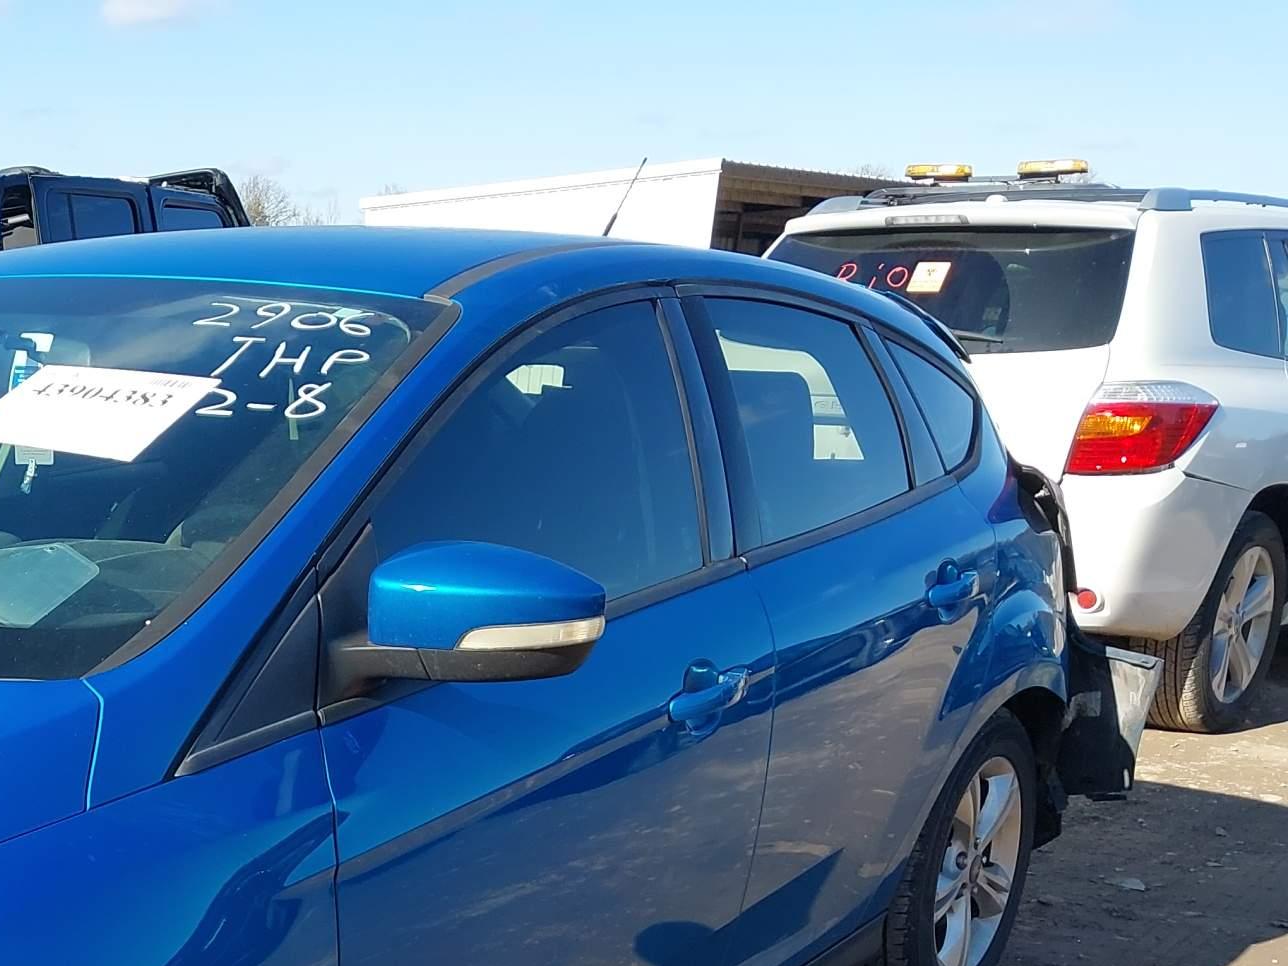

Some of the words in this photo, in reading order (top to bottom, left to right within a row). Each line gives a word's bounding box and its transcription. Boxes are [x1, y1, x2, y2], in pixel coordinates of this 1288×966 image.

[192, 302, 372, 336] 2906
[210, 336, 371, 378] THP
[32, 382, 173, 407] 43904383
[194, 381, 333, 420] 2-8
